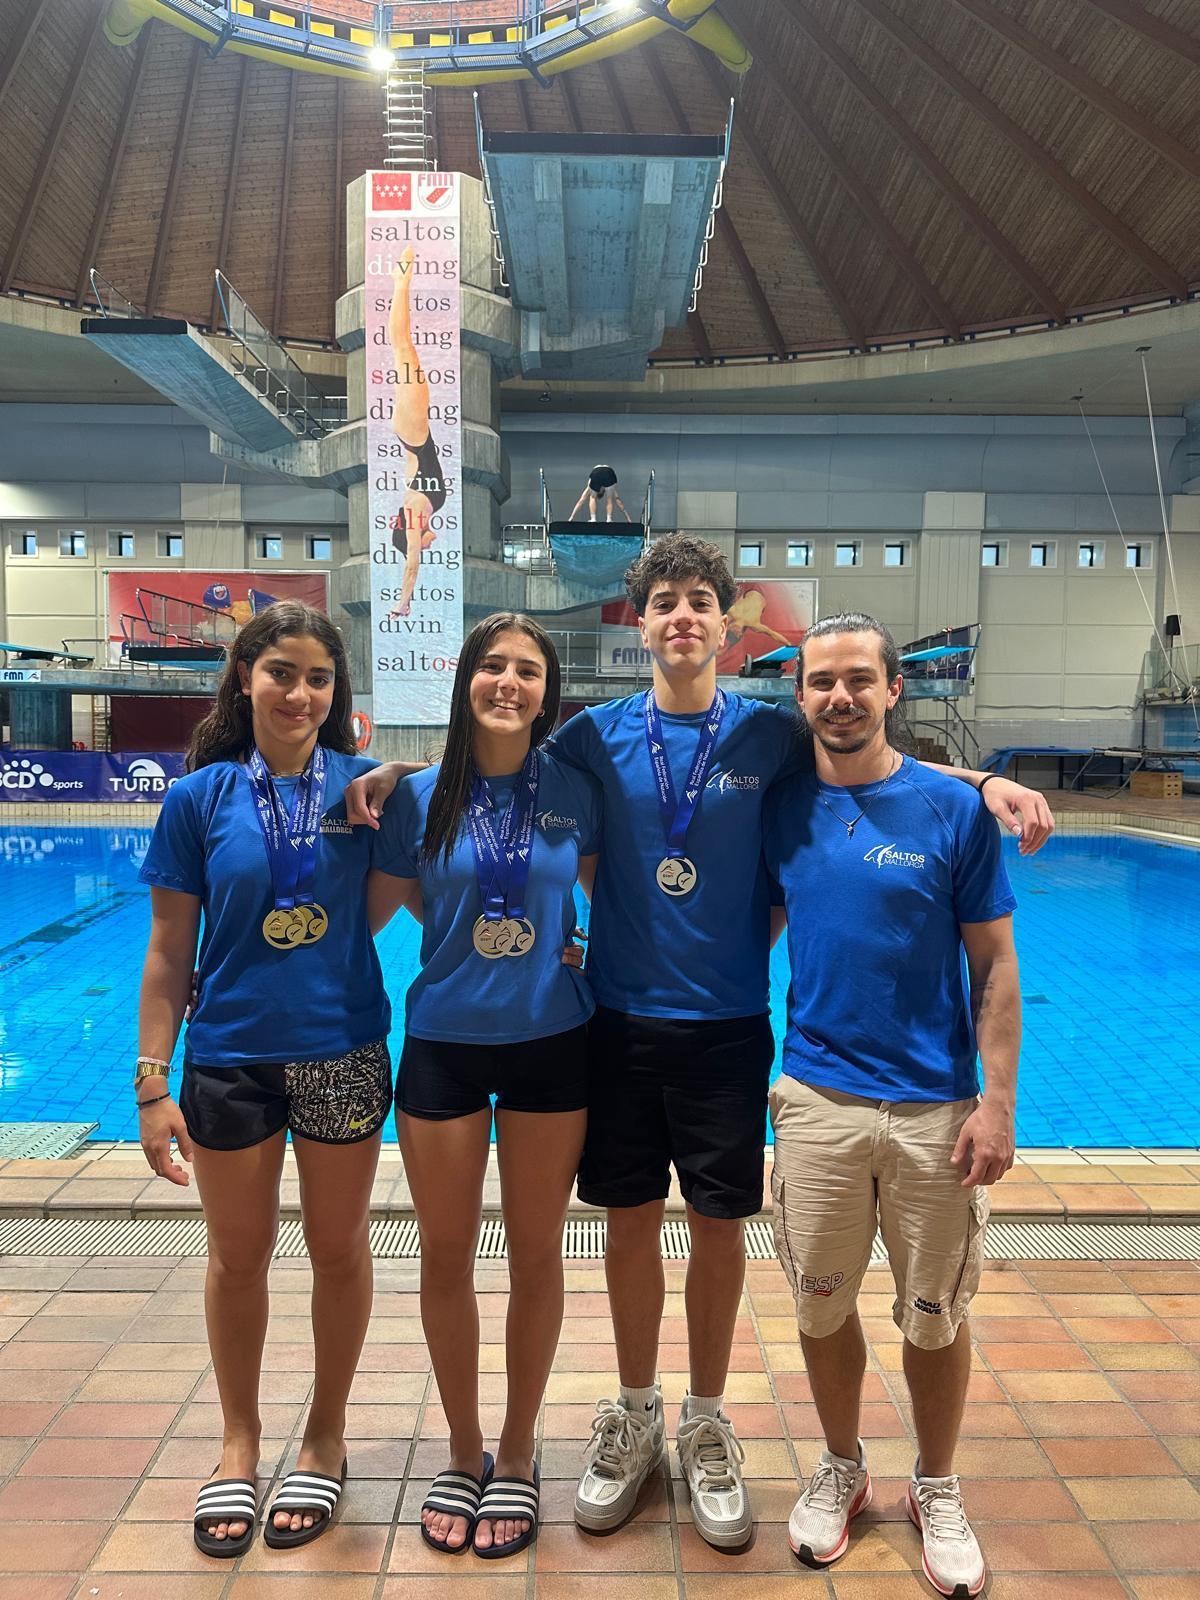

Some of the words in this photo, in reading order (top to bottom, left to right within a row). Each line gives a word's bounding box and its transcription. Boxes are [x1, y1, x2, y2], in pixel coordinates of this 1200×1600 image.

[371, 219, 455, 241] saltos
[368, 254, 458, 279] diving
[375, 293, 451, 311] stos
[373, 325, 453, 349] ding
[372, 362, 455, 384] saltos
[369, 397, 459, 425] ding
[375, 470, 456, 497] diving
[374, 508, 458, 530] saltos
[373, 542, 461, 570] diing
[377, 650, 459, 671] saltos
[0, 770, 36, 789] CD
[53, 780, 84, 791] sports
[726, 776, 760, 785] SALTOS
[546, 815, 578, 827] SALTOS
[884, 850, 925, 863] SALTOS
[884, 858, 925, 870] MALLORCA
[801, 1271, 844, 1293] ESP
[914, 1302, 942, 1315] WAVE
[916, 1297, 941, 1309] MAD
